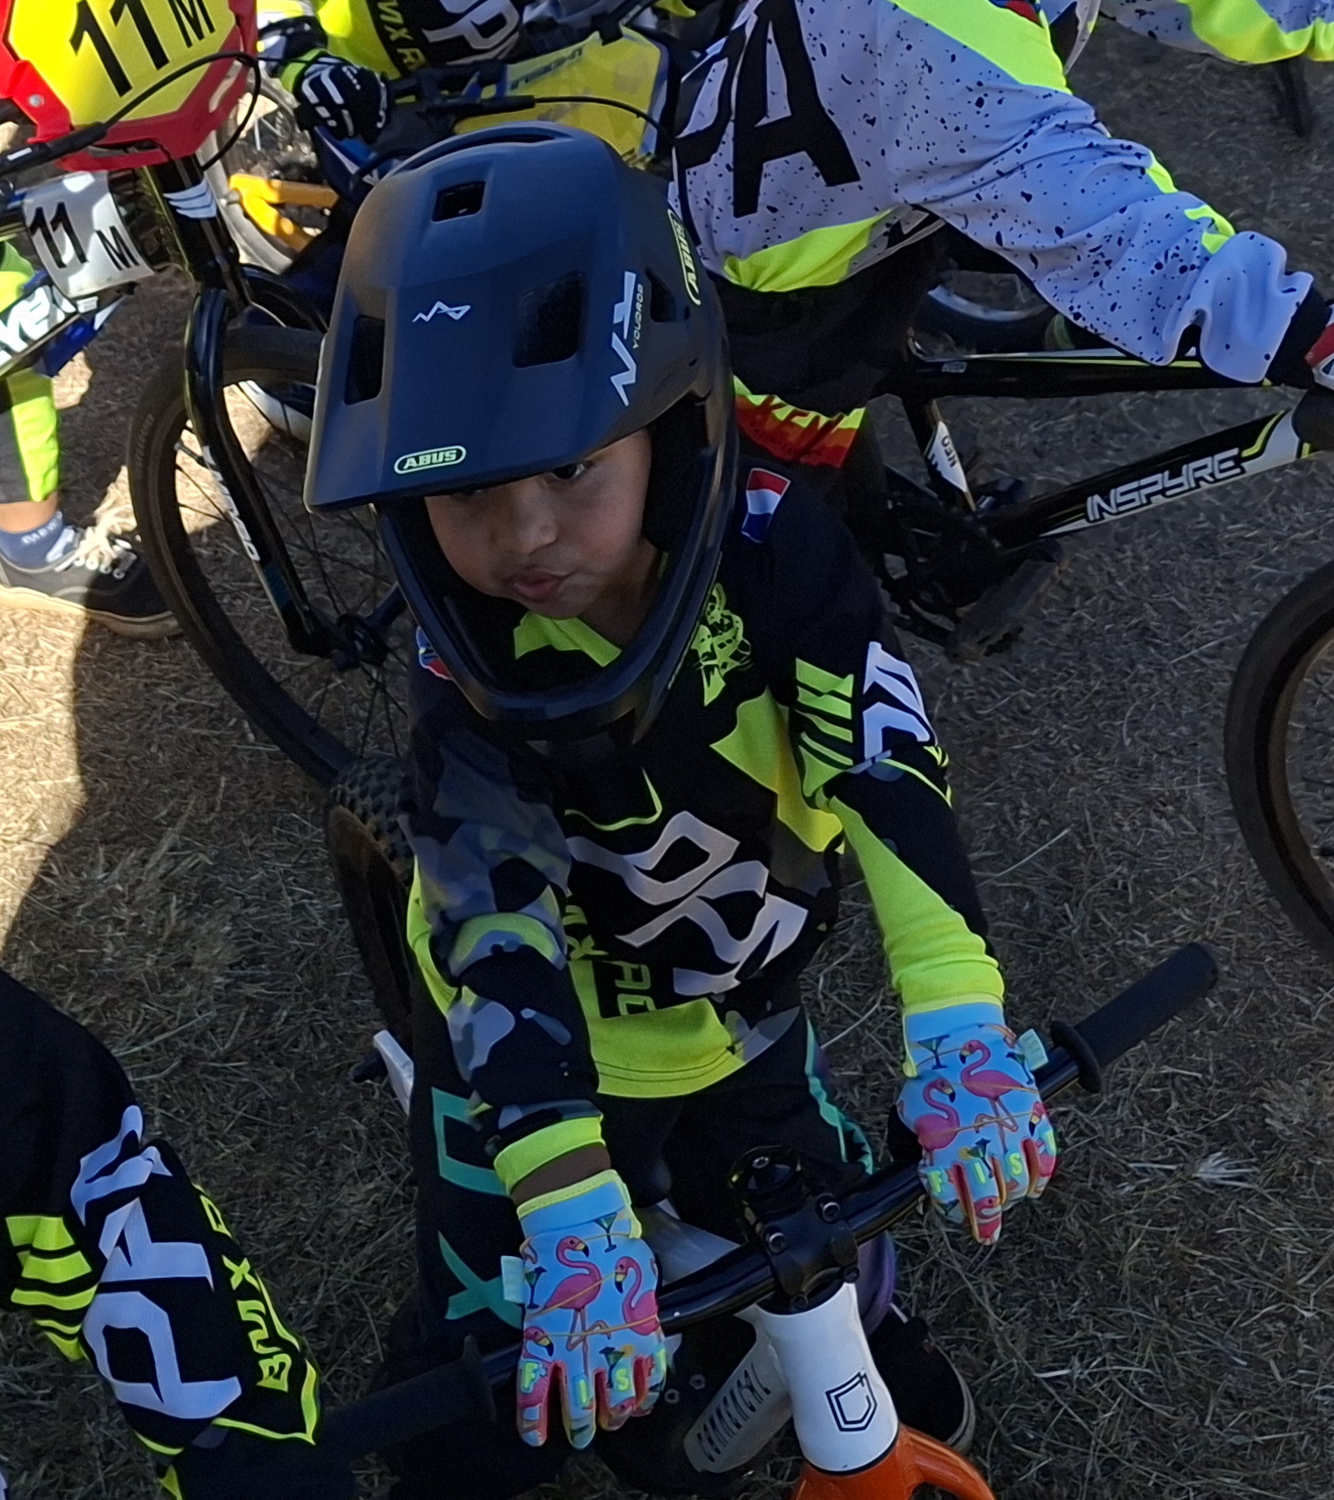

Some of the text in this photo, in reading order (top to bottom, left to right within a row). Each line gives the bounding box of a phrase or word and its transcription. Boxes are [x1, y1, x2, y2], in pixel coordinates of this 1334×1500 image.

[29, 201, 141, 271] 11 M
[631, 283, 645, 350] YOUDROP
[399, 448, 460, 471] ABUS
[1086, 446, 1243, 522] INSPYRE
